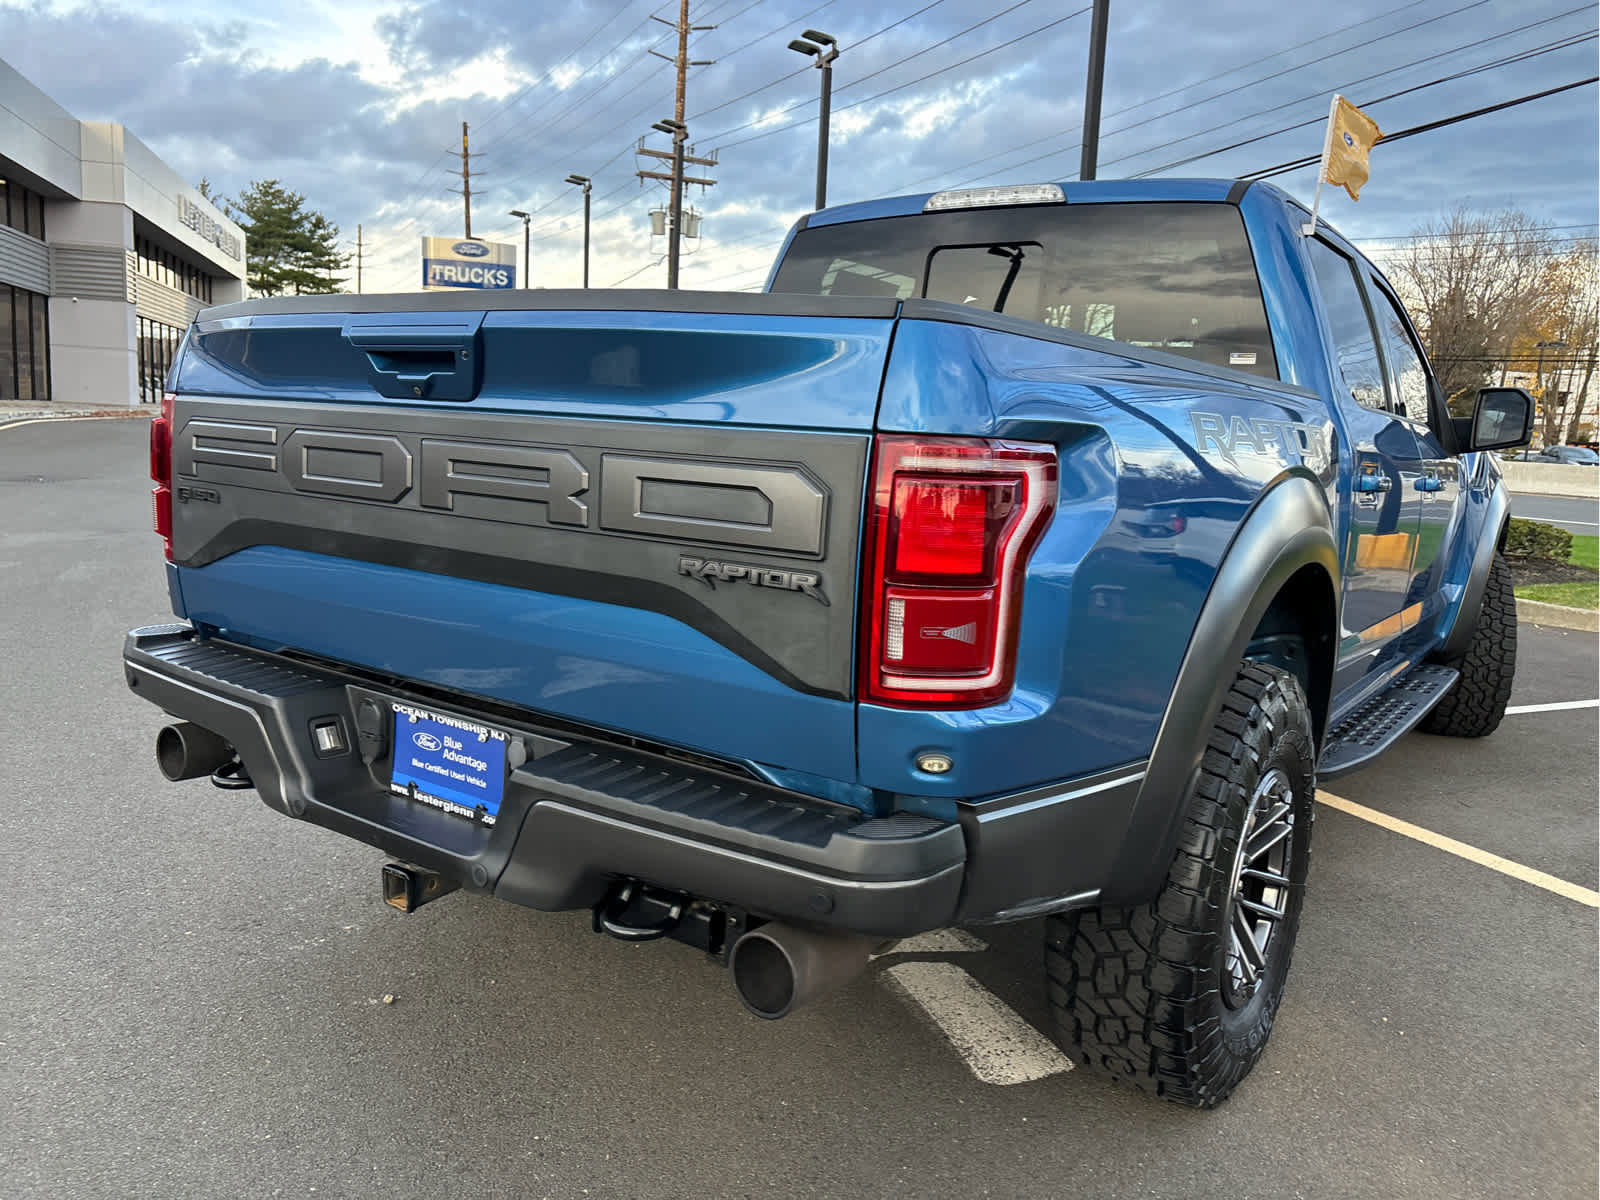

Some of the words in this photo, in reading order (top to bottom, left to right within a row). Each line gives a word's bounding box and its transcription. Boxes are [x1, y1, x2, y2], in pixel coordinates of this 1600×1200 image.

[459, 244, 481, 255] Ford
[431, 264, 509, 286] TRUCKS
[178, 419, 826, 558] FORD
[679, 555, 831, 607] RAPTOR
[392, 704, 428, 720] OCEAN
[430, 712, 488, 736] TOWNSHIP
[491, 729, 505, 742] NJ
[417, 734, 437, 749] Ford
[443, 736, 462, 750] Blue
[412, 758, 424, 768] Blue
[424, 762, 449, 777] Certified
[450, 769, 465, 782] Used
[466, 775, 488, 789] Vehicle
[442, 749, 487, 771] Advantage
[391, 783, 409, 796] www.
[414, 791, 474, 818] lesterglenn
